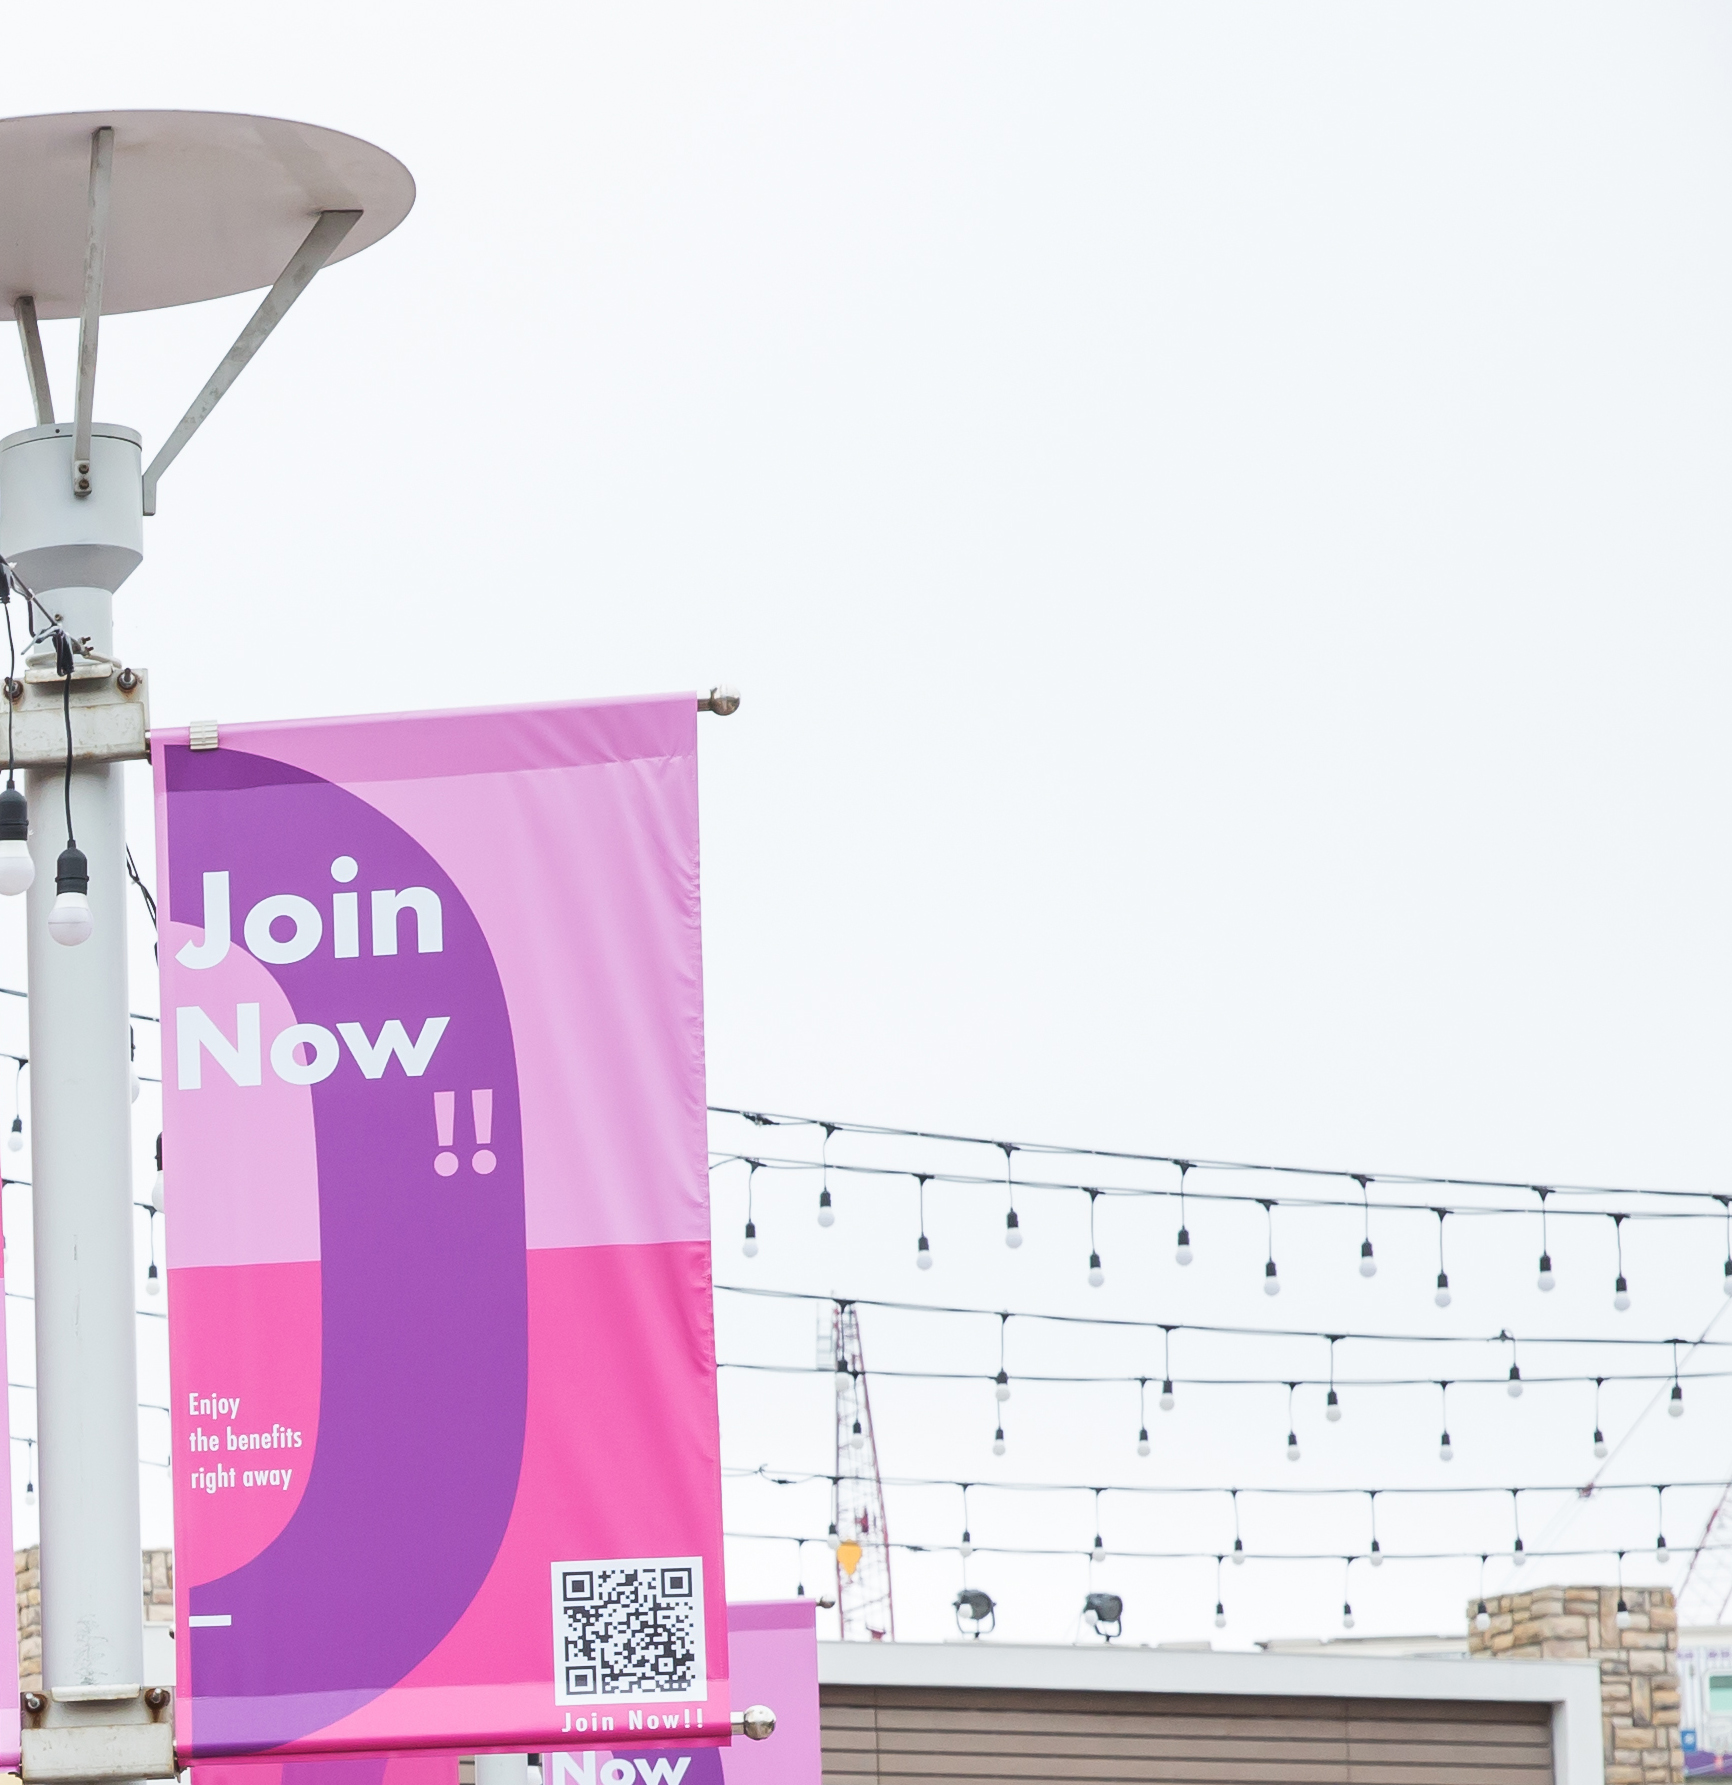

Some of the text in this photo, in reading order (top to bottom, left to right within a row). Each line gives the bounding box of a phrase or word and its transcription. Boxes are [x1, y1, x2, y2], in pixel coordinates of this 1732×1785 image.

[175, 856, 444, 970] Join
[176, 1002, 451, 1090] Now
[433, 1088, 497, 1177] !!
[188, 1392, 241, 1420] Enjoy
[188, 1423, 303, 1452] the benefits
[191, 1462, 293, 1494] right away
[561, 1707, 704, 1733] Join Now!!
